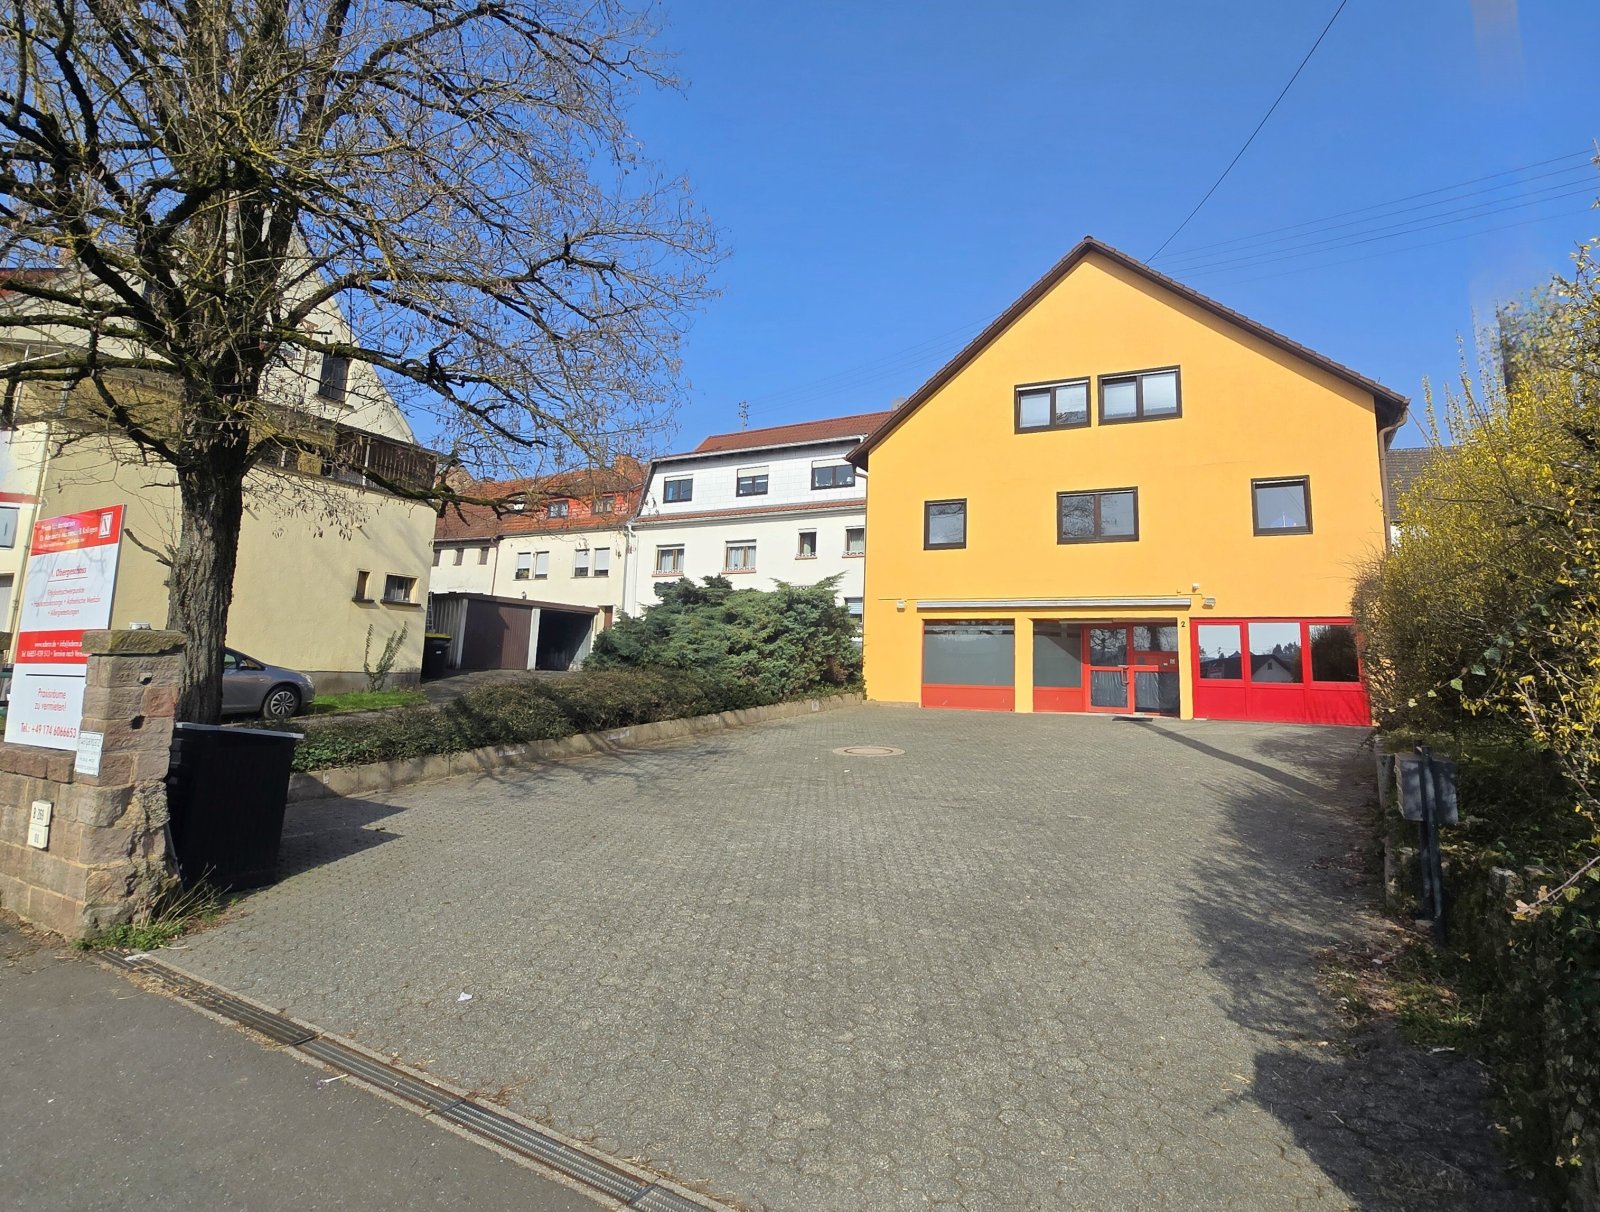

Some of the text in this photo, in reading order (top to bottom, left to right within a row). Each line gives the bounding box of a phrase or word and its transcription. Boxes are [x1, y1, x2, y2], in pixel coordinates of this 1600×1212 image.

[56, 568, 86, 577] Obergeschoss
[38, 688, 66, 700] Praxisräume
[34, 702, 66, 712] zu vermieten!
[21, 722, 76, 738] Tel.: +49 174 6066653
